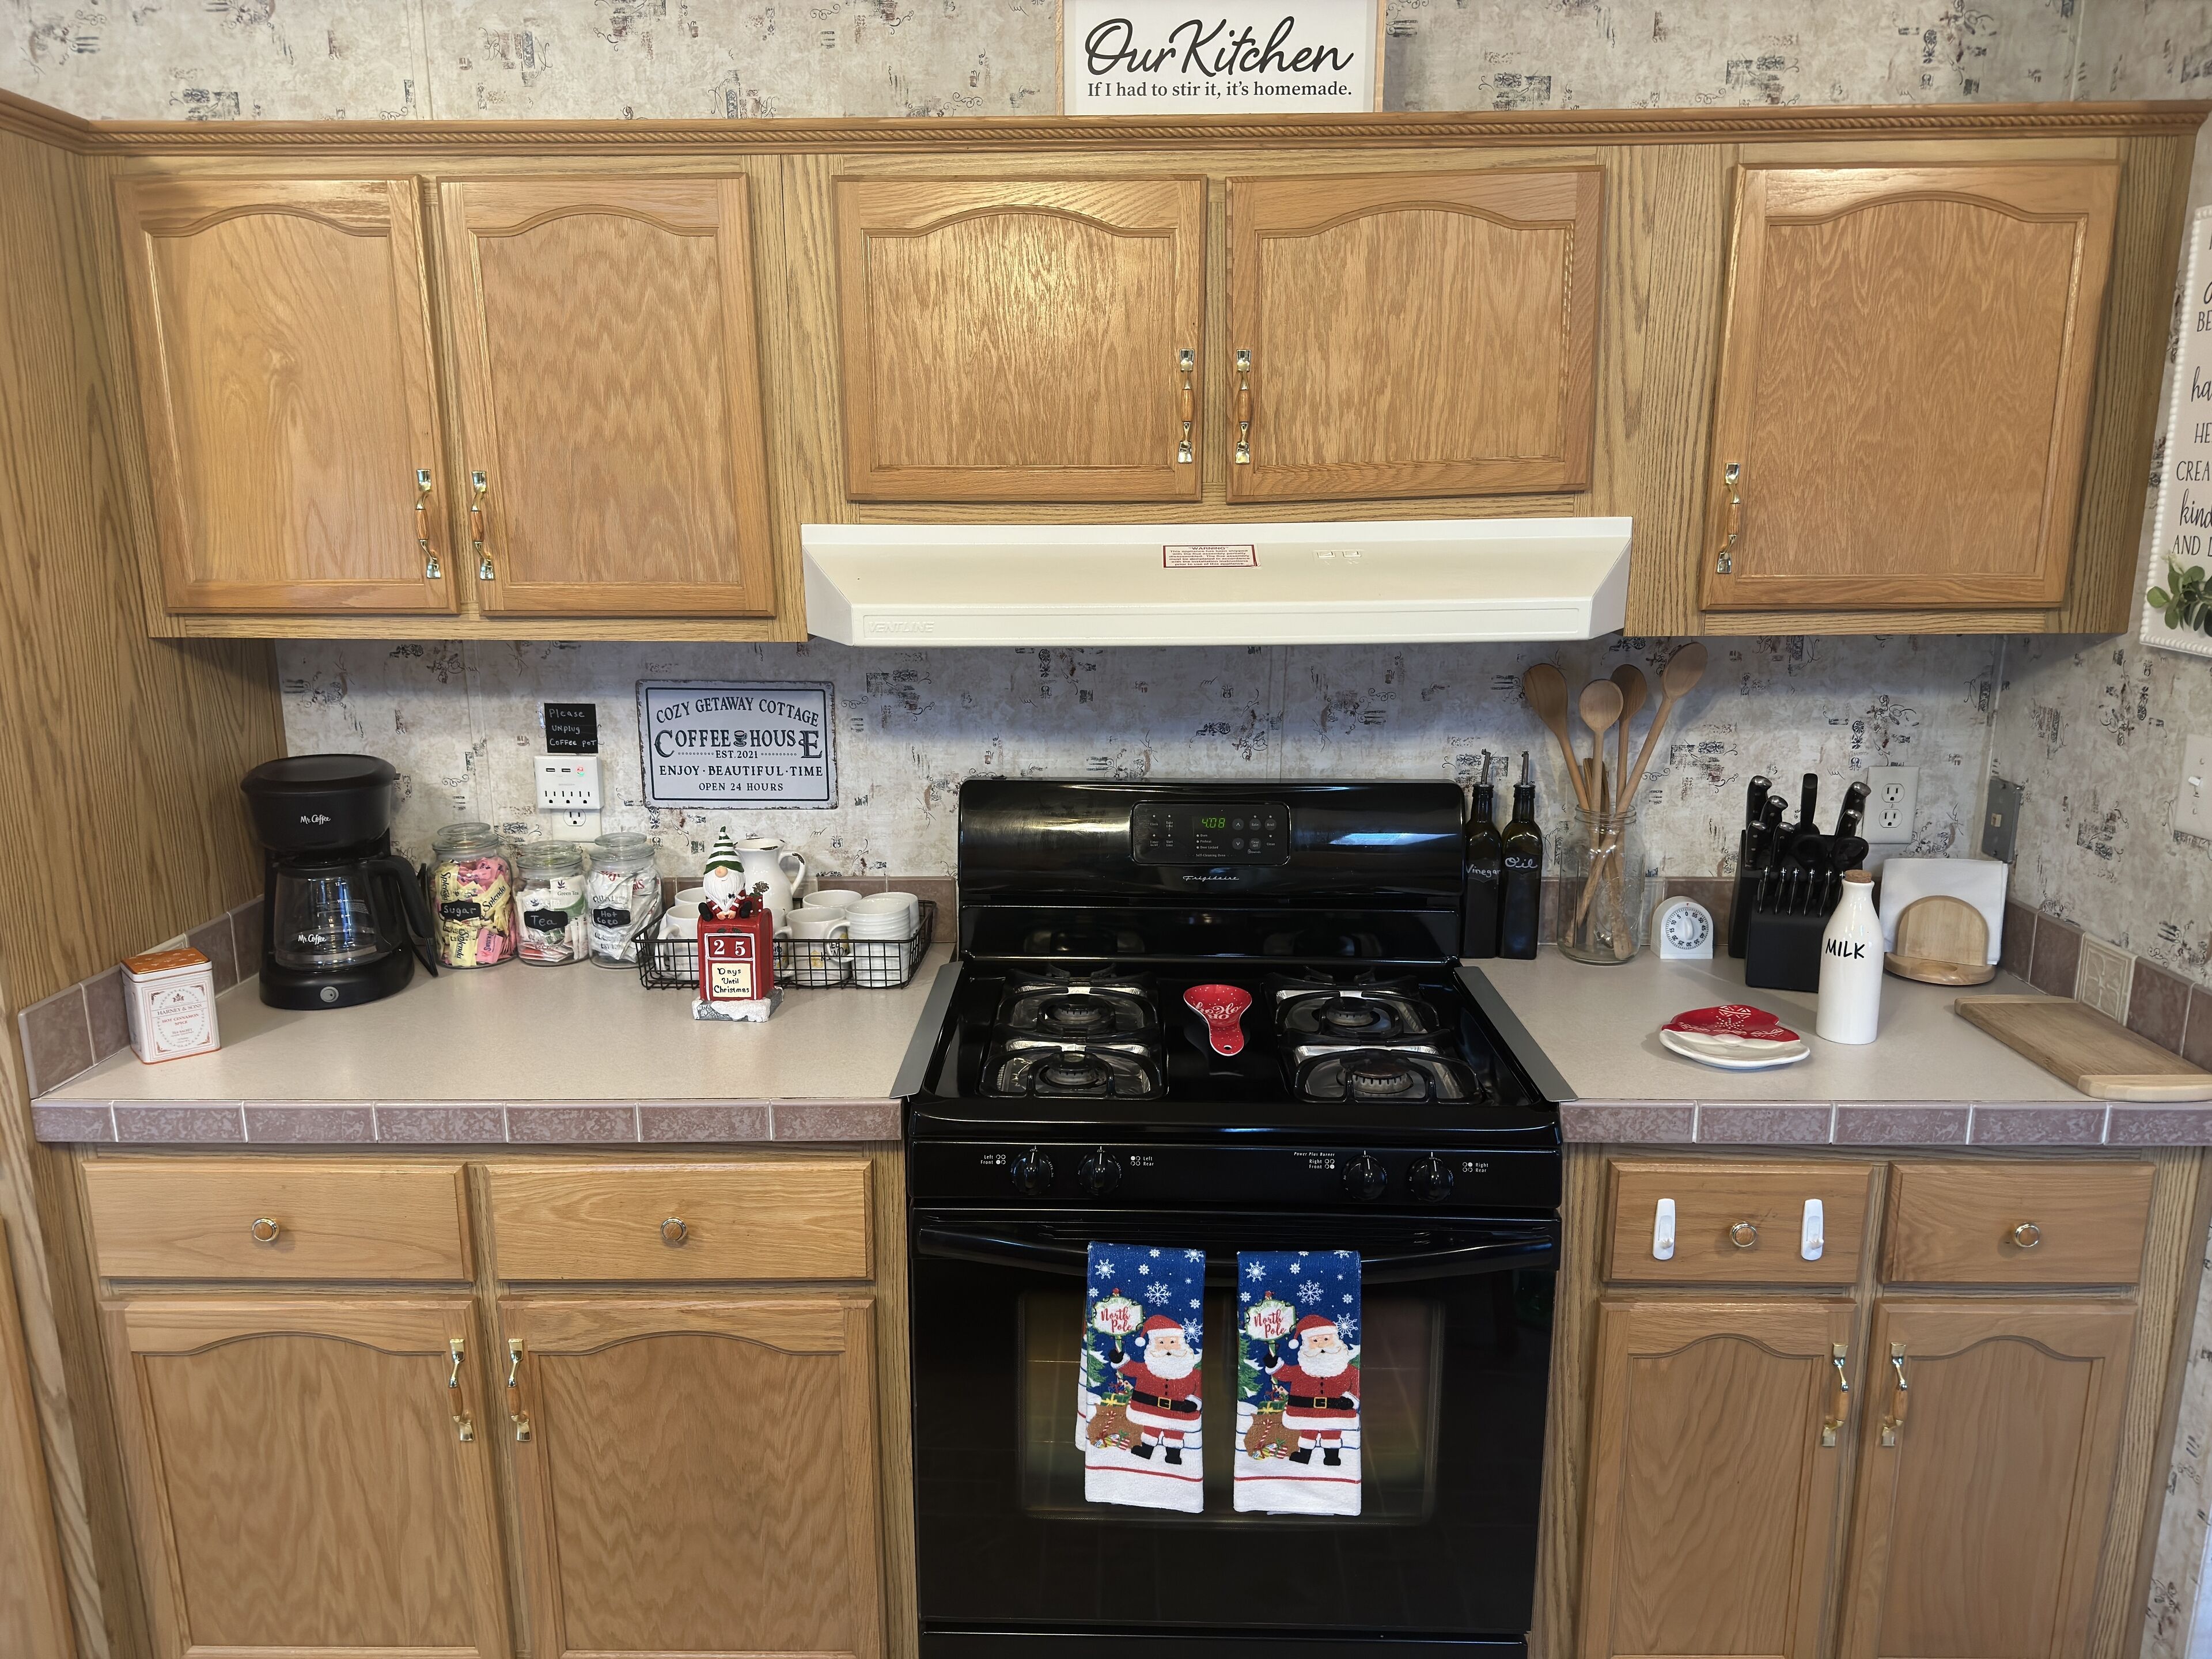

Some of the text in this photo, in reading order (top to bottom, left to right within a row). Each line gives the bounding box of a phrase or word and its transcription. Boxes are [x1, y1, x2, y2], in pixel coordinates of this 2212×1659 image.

[1085, 16, 1354, 78] Our Kitchen
[1088, 81, 1352, 99] If I had to stir it, it's homemade.
[2176, 460, 2212, 482] CREA
[2172, 534, 2200, 556] AND
[549, 709, 585, 719] Please
[656, 696, 819, 728] COZY GETAWAY COTTAGE
[654, 729, 823, 759] COFFEE HOUSE
[659, 765, 823, 777] ENJOY BEAUTIFUL TIME
[699, 782, 783, 791] OPEN 24 HOURS
[300, 814, 331, 825] Mr. Coffee
[1505, 857, 1537, 869] Oil
[1465, 863, 1501, 879] Vinegar
[441, 872, 451, 901] Splenda
[483, 885, 505, 912] Splenda
[444, 905, 476, 917] Sugar
[531, 915, 557, 926] Tea
[298, 933, 327, 944] Mr. Coffee
[456, 929, 469, 959] Splenda
[1825, 938, 1866, 960] MILK
[717, 968, 741, 976] Days
[714, 985, 749, 994] Christmas
[157, 1007, 181, 1016] HARNEY
[1101, 1306, 1130, 1321] North
[1254, 1309, 1284, 1327] North
[1111, 1319, 1133, 1333] Pole
[1264, 1323, 1286, 1339] Pole
